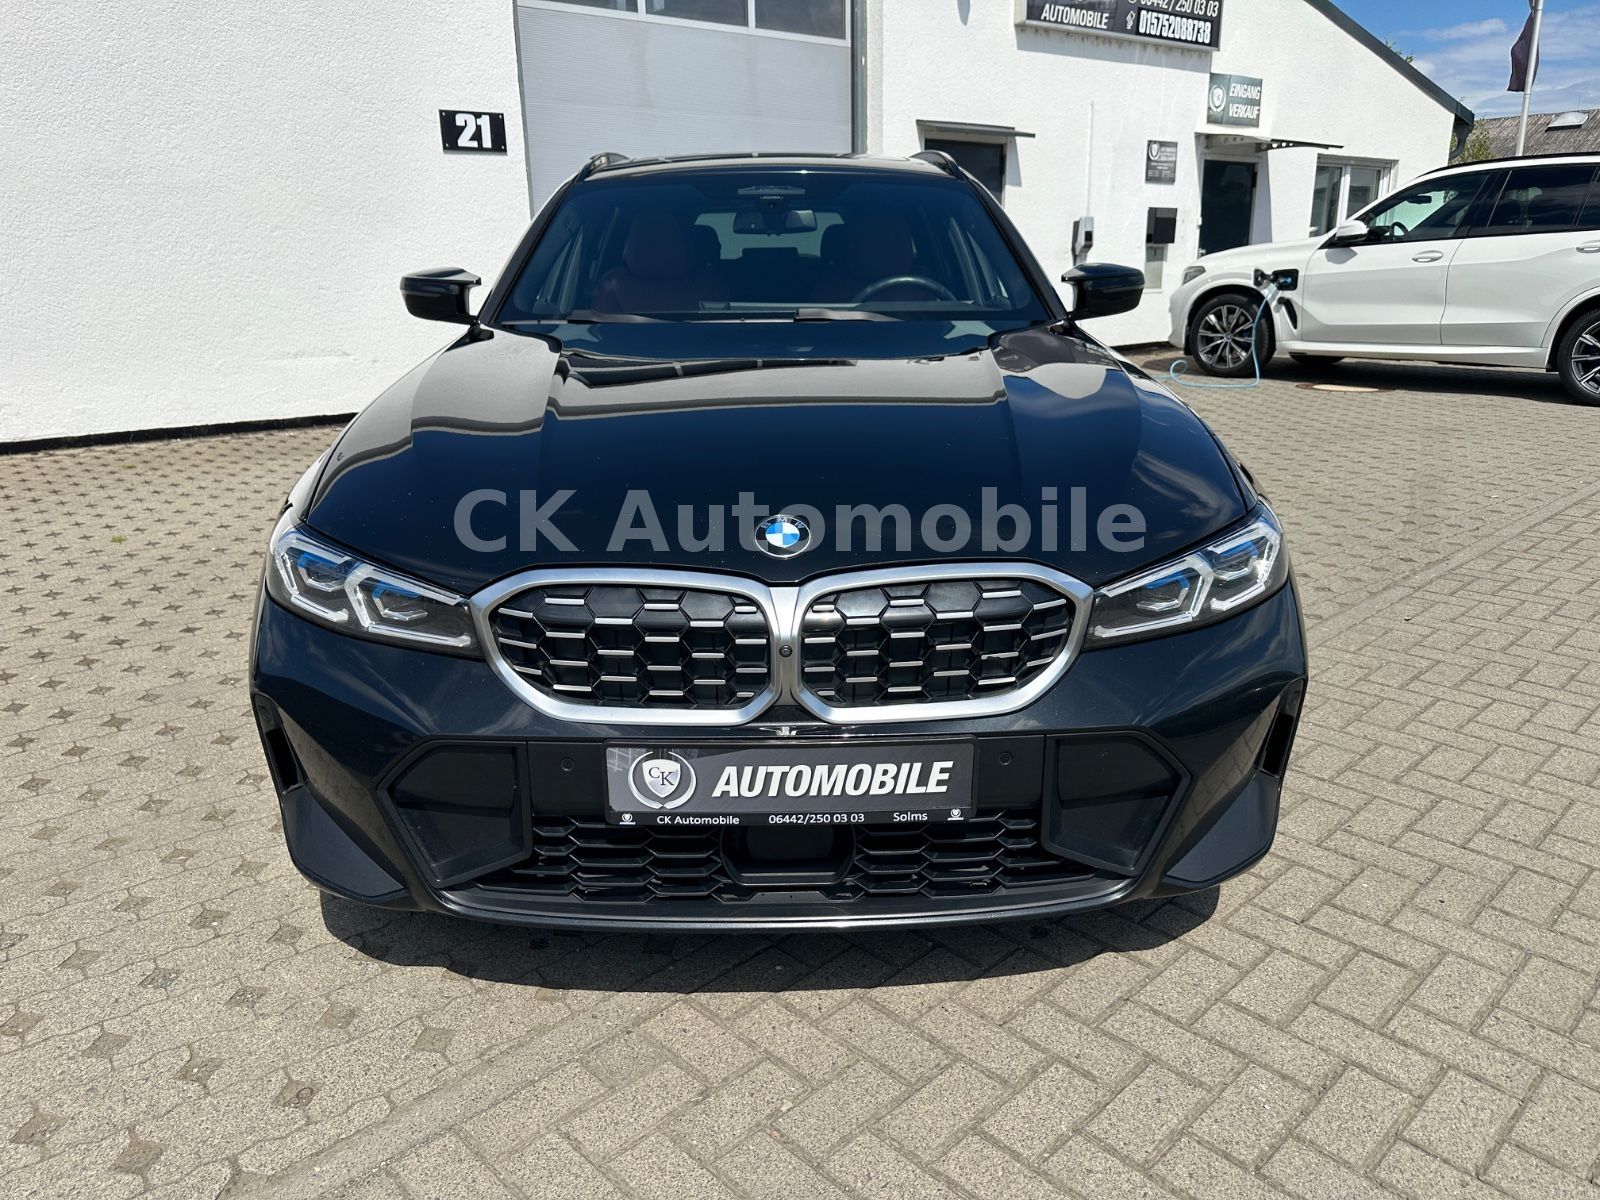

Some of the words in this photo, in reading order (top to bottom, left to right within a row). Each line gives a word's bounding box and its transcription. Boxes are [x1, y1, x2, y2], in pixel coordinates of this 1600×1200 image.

[1041, 3, 1110, 29] AUTOMOBILE
[1194, 0, 1206, 15] 03
[1207, 1, 1220, 17] 03
[1139, 9, 1212, 44] 015752088738
[1229, 83, 1261, 100] EINGANG
[1229, 103, 1260, 119] VERKAUF
[455, 113, 492, 149] 21
[761, 516, 806, 529] BMW
[648, 766, 675, 786] CK
[712, 761, 954, 798] AUTOMOBILE
[656, 815, 672, 825] CK
[674, 815, 740, 825] Automobile
[768, 813, 831, 825] 06442/250
[833, 813, 848, 823] 03
[850, 813, 865, 823] 03
[893, 811, 928, 822] Solms
